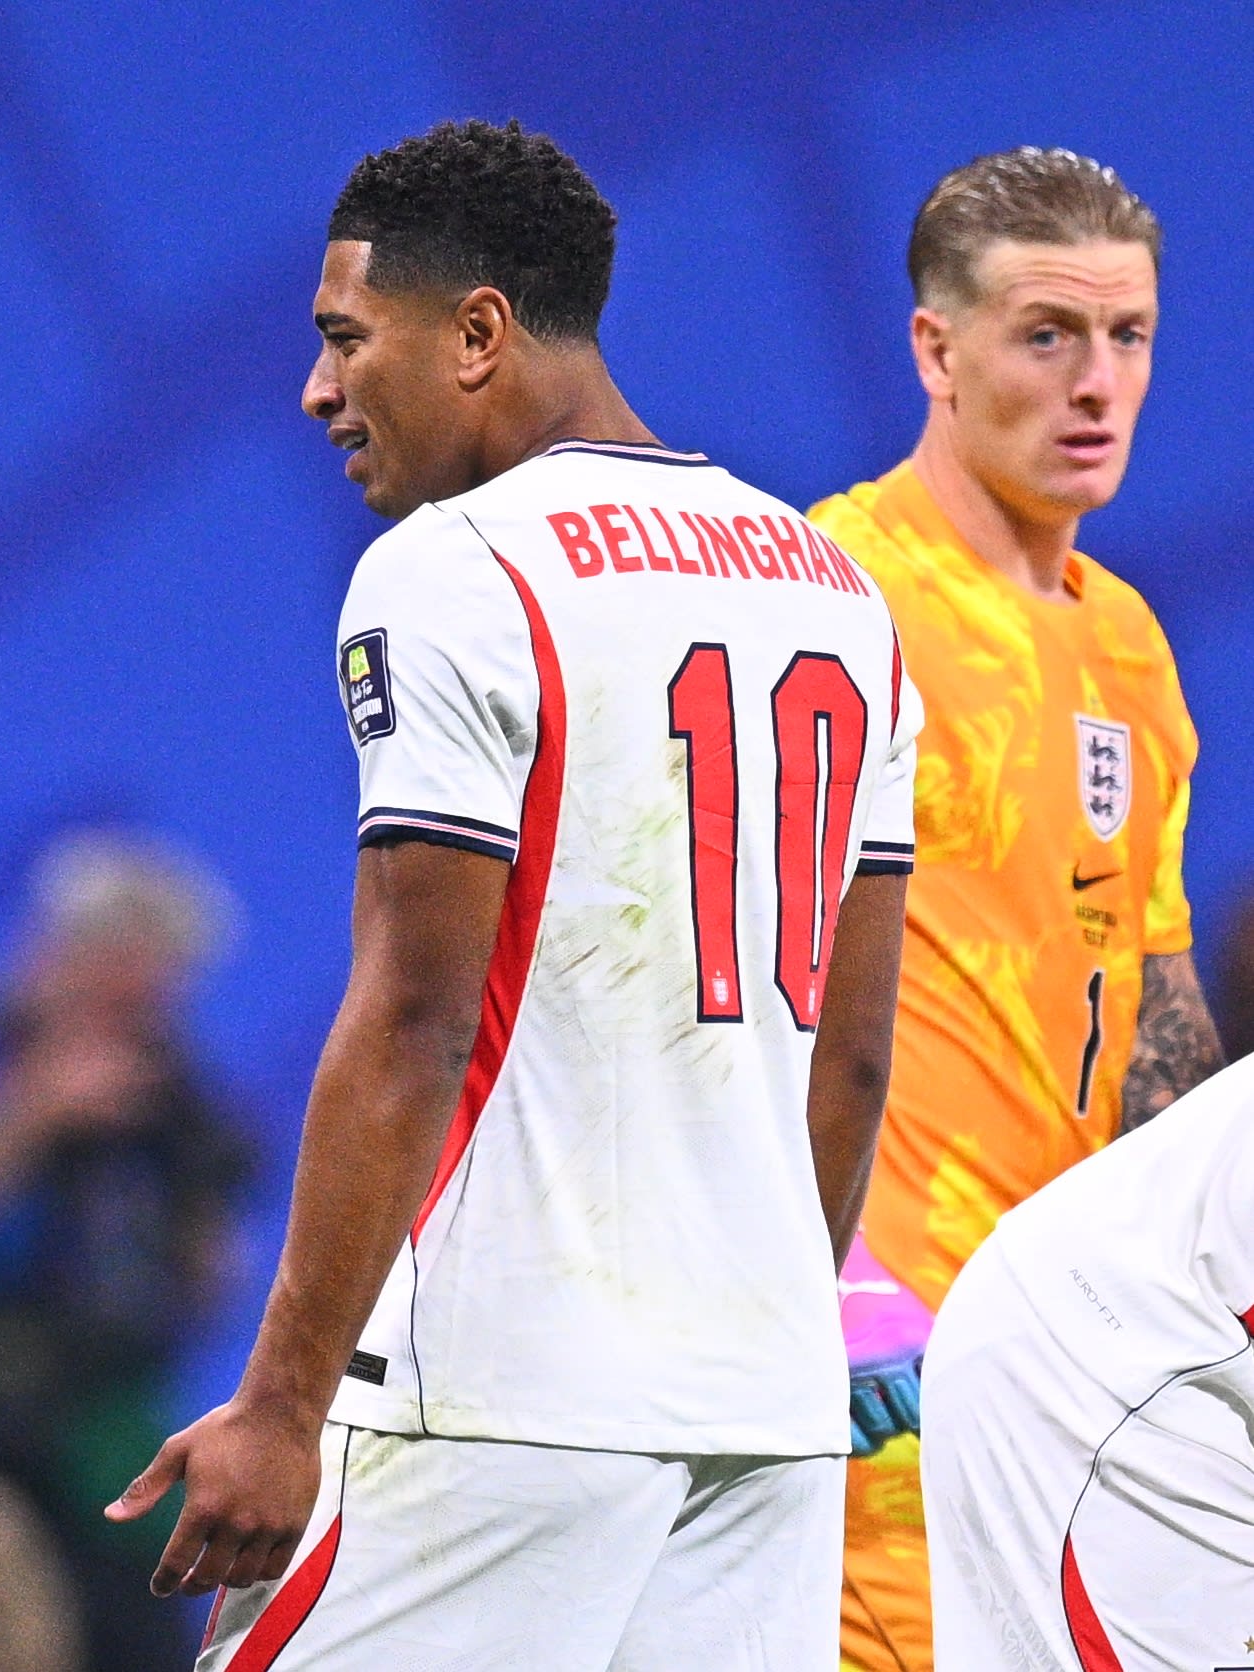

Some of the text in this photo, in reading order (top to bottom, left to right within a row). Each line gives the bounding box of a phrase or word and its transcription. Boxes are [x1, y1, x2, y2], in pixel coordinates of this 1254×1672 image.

[547, 504, 871, 597] BELLINGHAM
[668, 642, 868, 1033] 10
[1075, 968, 1105, 1118] 1
[1069, 1269, 1123, 1331] AERO-FIT
